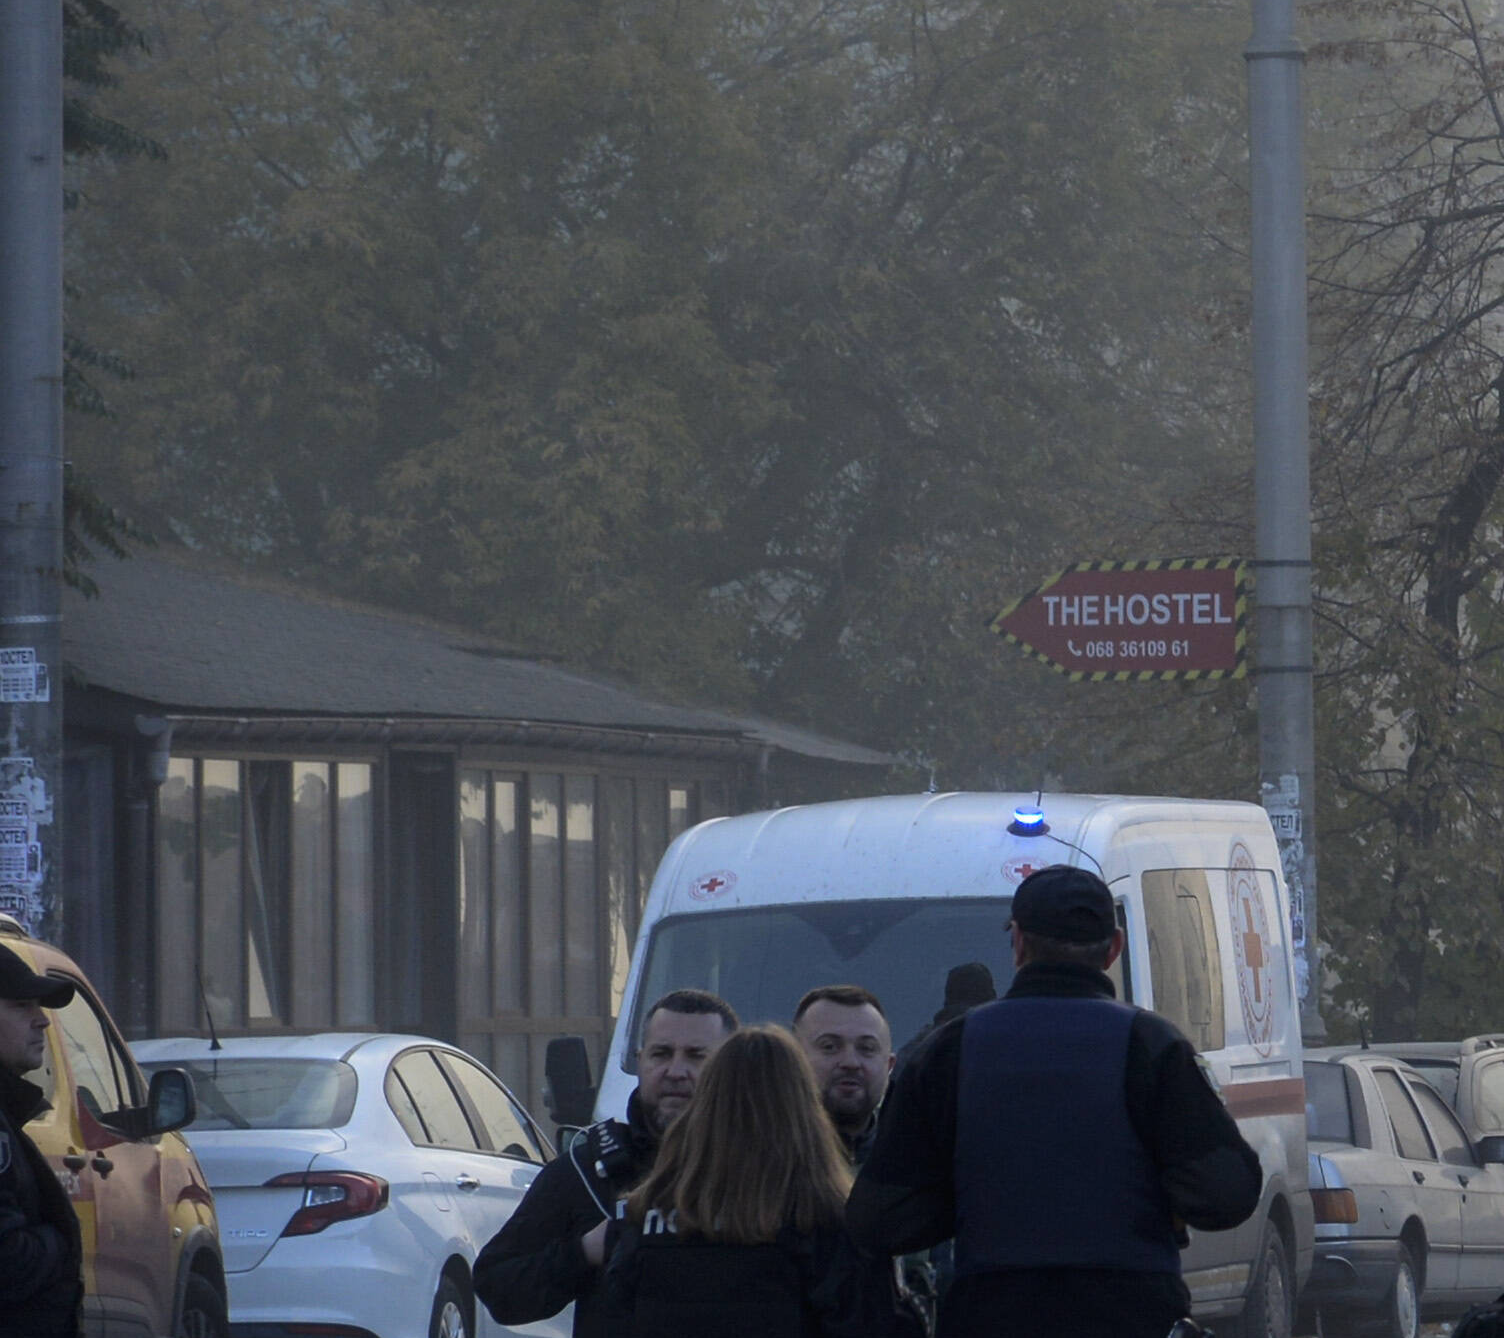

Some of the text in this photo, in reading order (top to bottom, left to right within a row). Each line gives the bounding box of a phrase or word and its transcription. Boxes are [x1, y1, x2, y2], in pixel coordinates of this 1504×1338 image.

[1086, 639, 1190, 658] 068 36109 61
